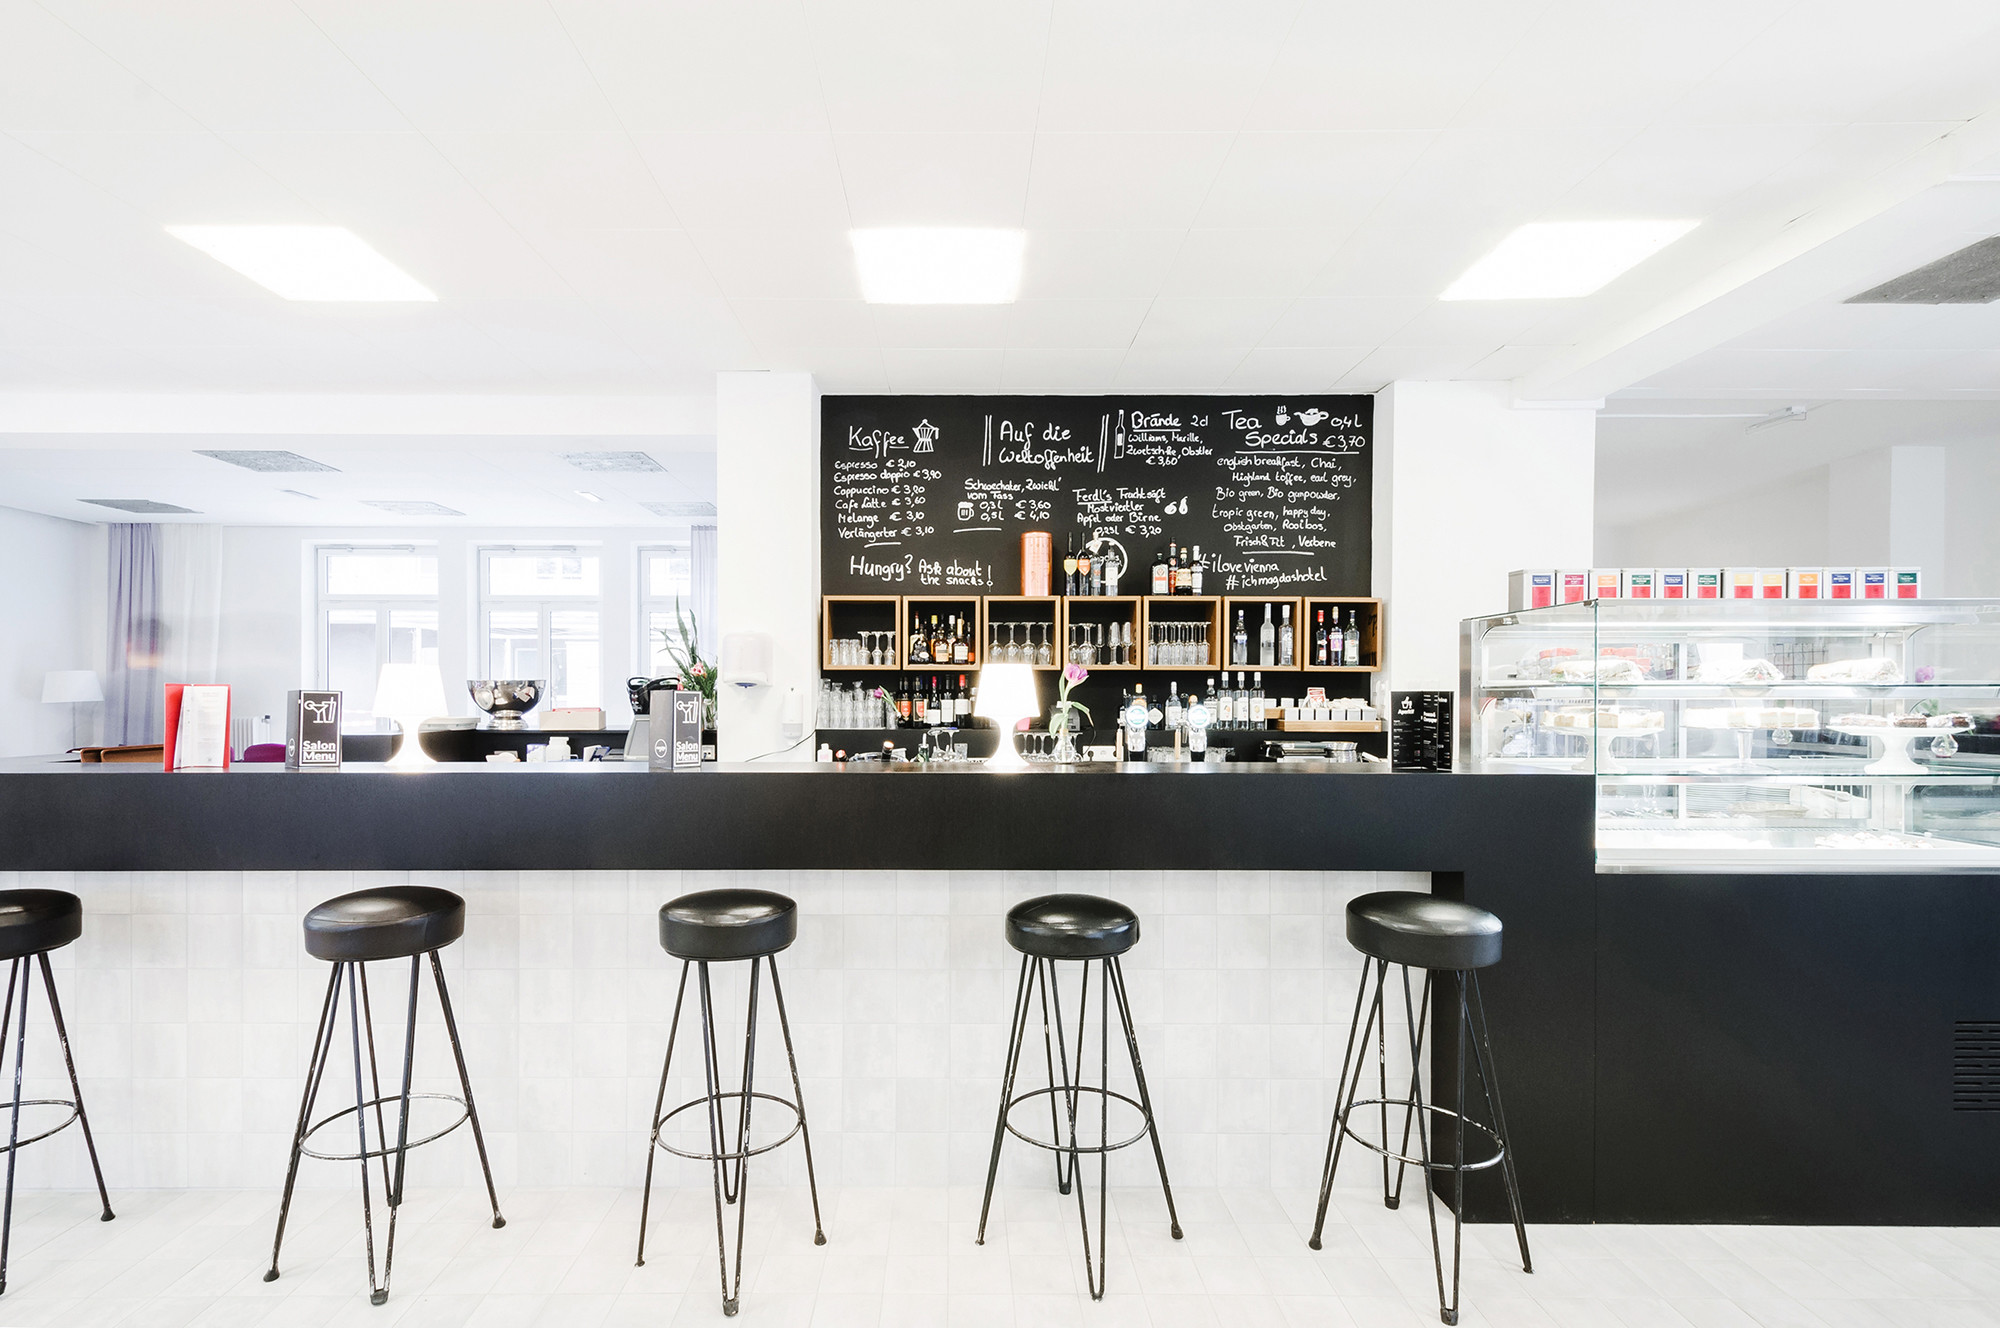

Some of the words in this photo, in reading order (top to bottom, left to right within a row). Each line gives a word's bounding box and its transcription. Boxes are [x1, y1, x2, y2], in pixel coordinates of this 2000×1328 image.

[1221, 409, 1263, 430] Tea
[848, 425, 905, 459] Kaffee
[1000, 420, 1034, 451] Auf
[1043, 422, 1072, 441] die
[1245, 428, 1318, 449] Specials
[998, 446, 1095, 470] Weltoffenheit
[1310, 457, 1342, 471] Chai,
[834, 460, 878, 472] Espresso
[897, 459, 917, 469] 2,10
[833, 472, 878, 485] Espresso
[880, 468, 911, 483] doppio
[1232, 472, 1271, 488] Highland
[1275, 472, 1307, 486] toffee,
[1310, 472, 1328, 482] earl
[833, 485, 890, 499] Cappuccino
[967, 491, 988, 500] vom
[990, 490, 1014, 500] Fass
[1215, 486, 1235, 501] Bio
[1266, 486, 1284, 500] Bio
[1029, 499, 1052, 511] 3,60
[837, 512, 880, 529] Melange
[906, 510, 925, 522] 3,10
[1029, 510, 1050, 521] 4,10
[1104, 513, 1124, 522] oder
[1128, 511, 1162, 523] Birne
[1211, 503, 1244, 519] tropic
[1246, 509, 1279, 522] green,
[915, 526, 935, 537] 3,10
[1139, 525, 1163, 538] 3,20
[850, 553, 914, 582] Hungry?
[918, 558, 942, 575] Ask
[946, 559, 983, 577] about
[920, 574, 941, 586] the
[303, 740, 336, 750] Salon
[676, 741, 699, 752] Salon
[303, 751, 336, 761] Menu
[676, 752, 699, 761] Menu
